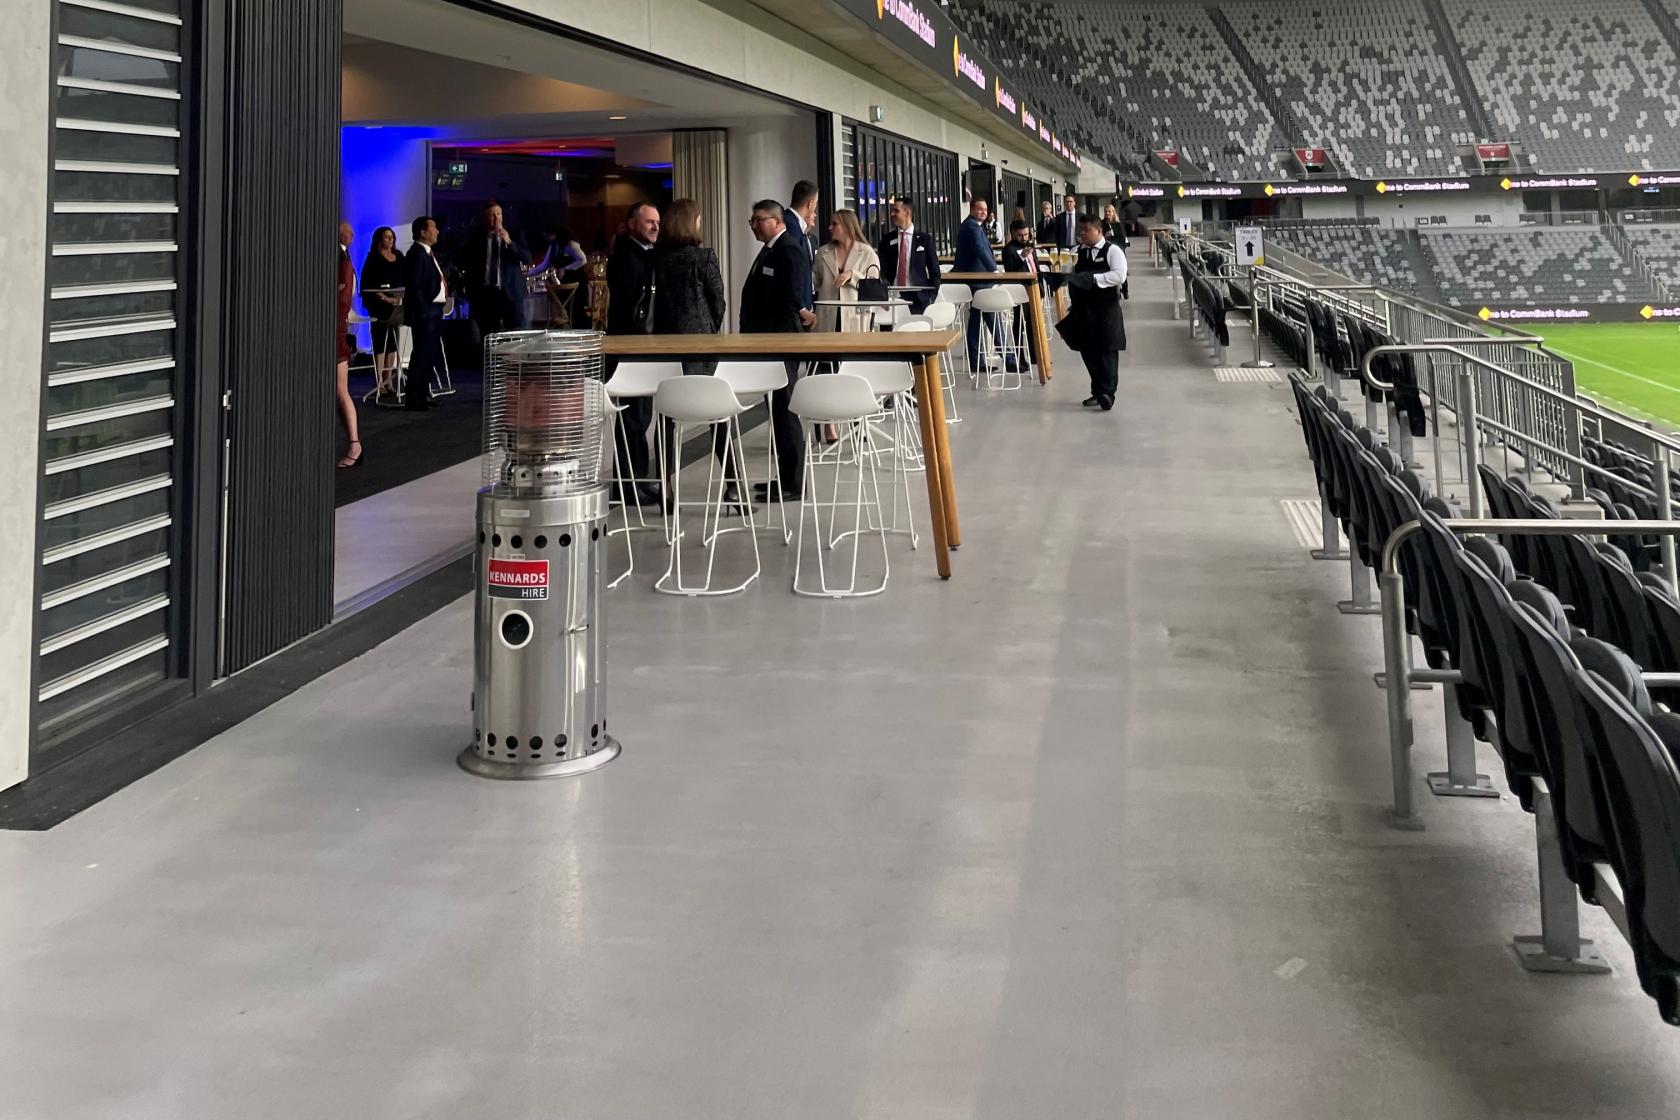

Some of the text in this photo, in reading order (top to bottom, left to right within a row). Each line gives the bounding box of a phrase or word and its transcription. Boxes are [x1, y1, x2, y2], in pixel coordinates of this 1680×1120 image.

[1509, 309, 1555, 318] CommBank
[489, 572, 546, 584] KENNARDS
[521, 588, 545, 598] HIRE
